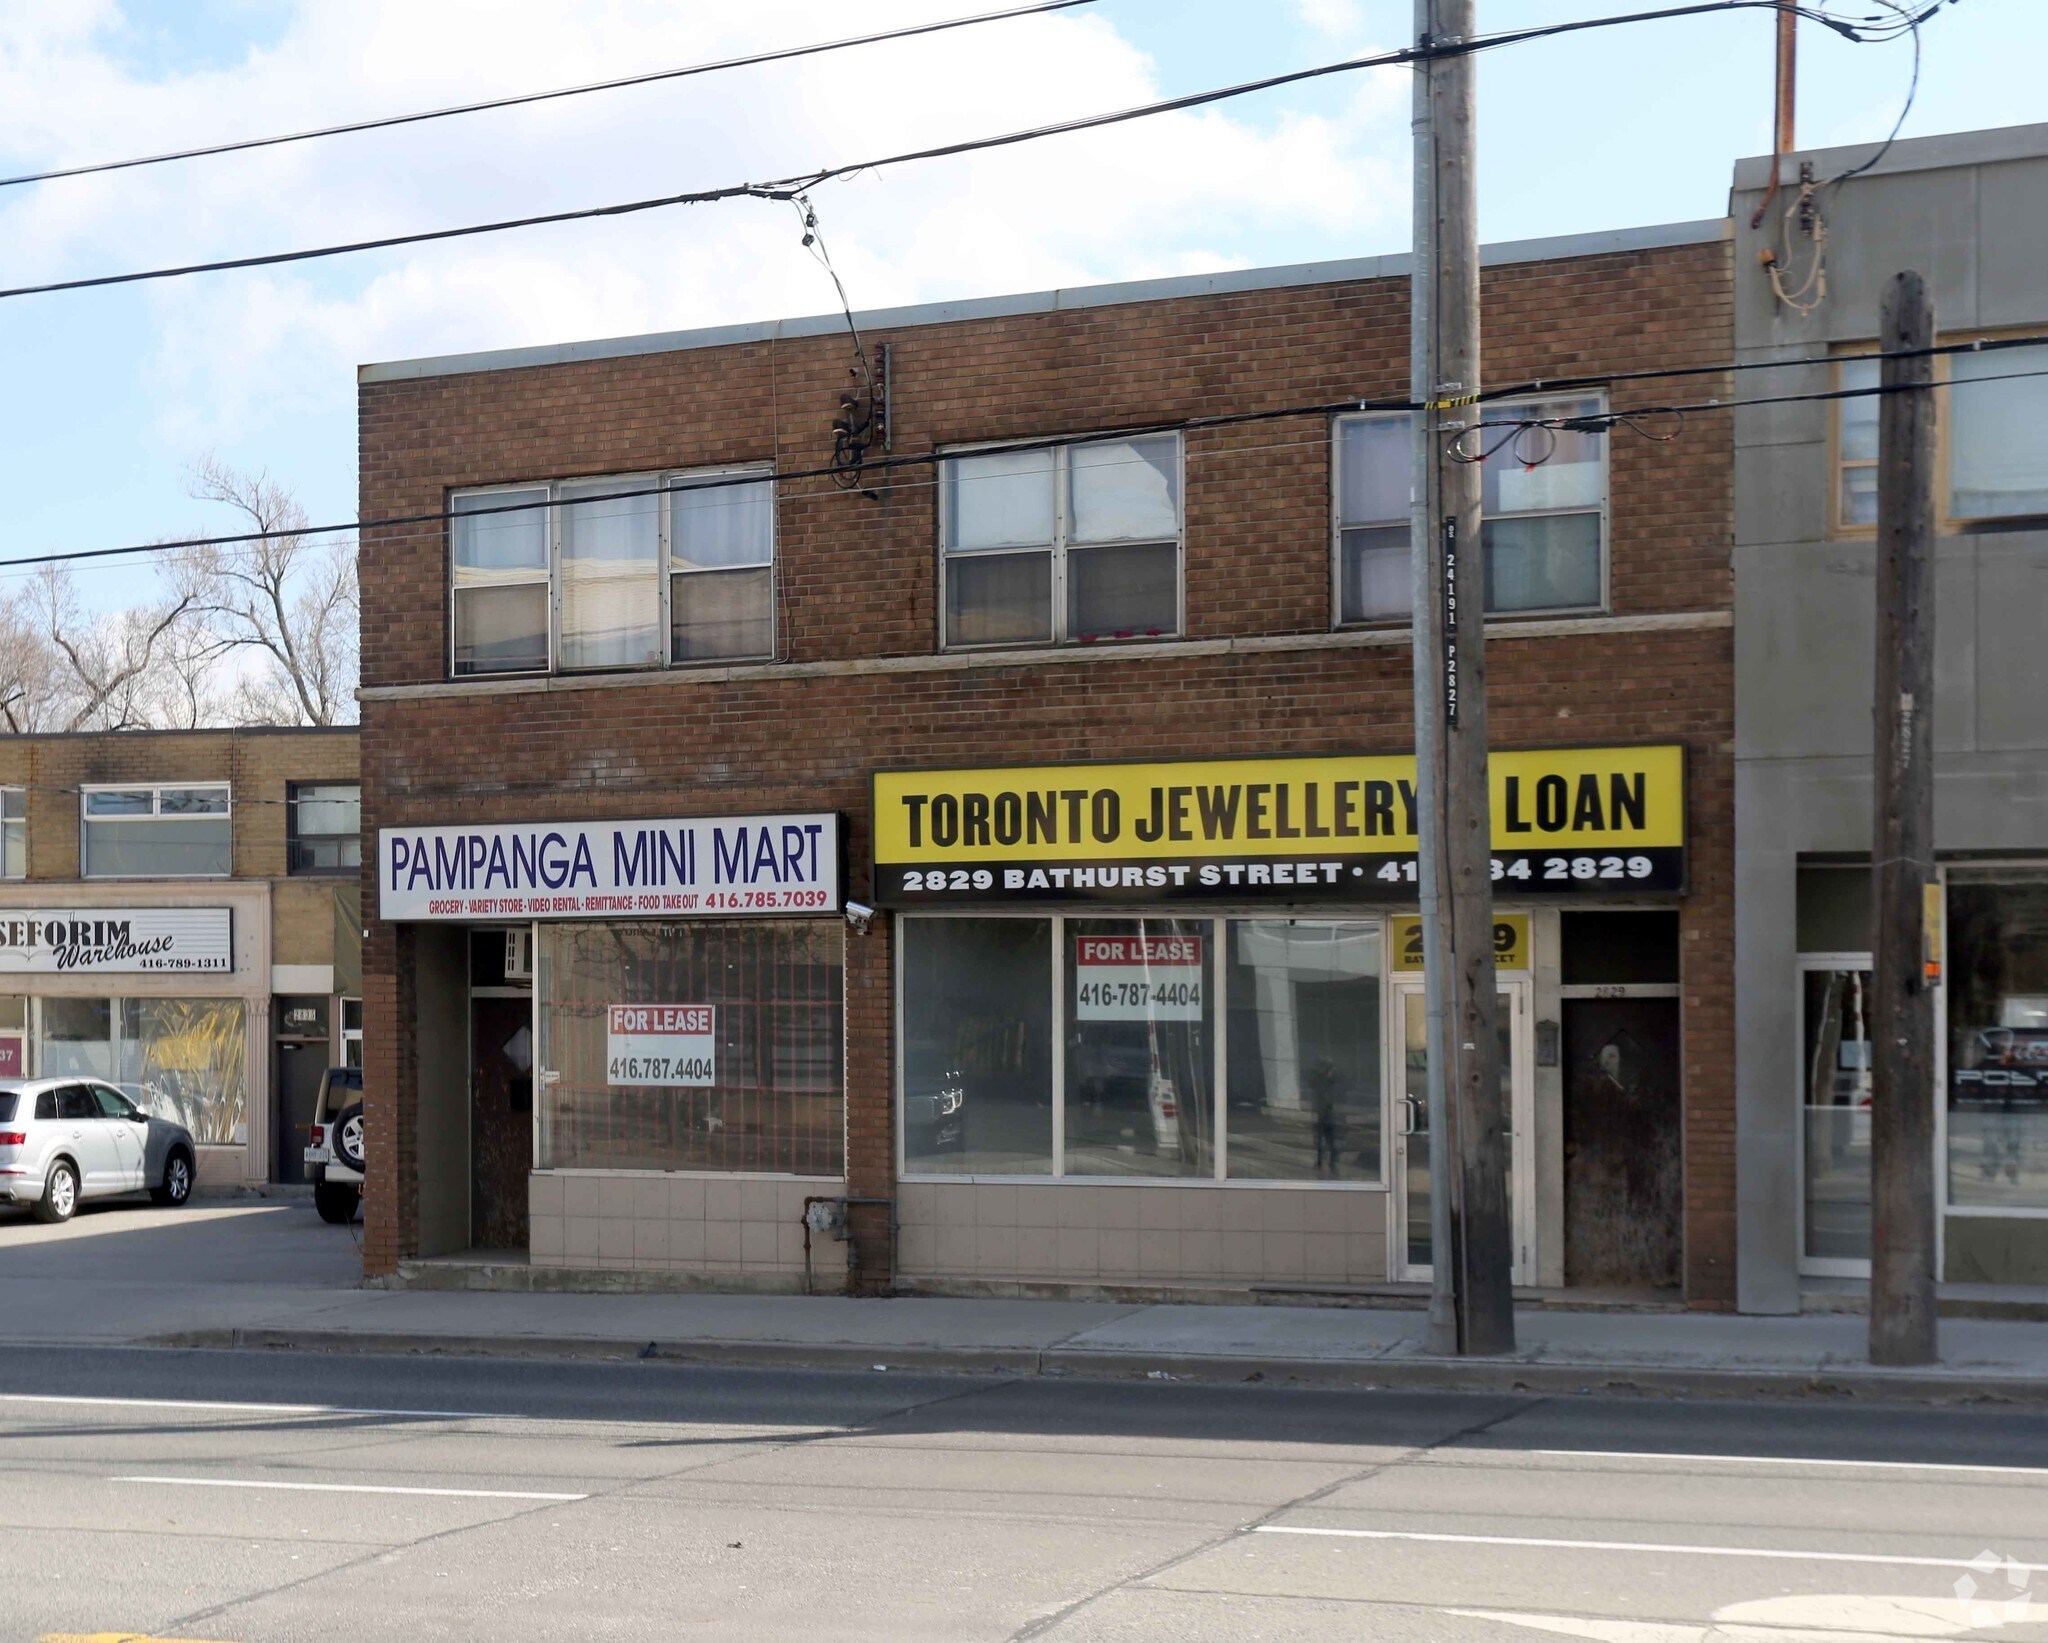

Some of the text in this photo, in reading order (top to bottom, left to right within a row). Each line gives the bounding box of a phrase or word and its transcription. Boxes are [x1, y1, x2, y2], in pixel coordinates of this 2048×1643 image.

[1446, 554, 1456, 625] 24191
[1448, 645, 1456, 716] P2827
[901, 772, 1646, 848] TORONTO JEWELLERY LOAN
[391, 824, 823, 892] PAMPANGA MINI MART
[902, 869, 994, 892] 2829
[1003, 865, 1190, 890] BATHURST
[1199, 863, 1343, 887] STREET
[1543, 855, 1653, 880] 2829
[429, 890, 827, 914] GROCERY VARIETY STORE VIDEO RENTAL REMITTANCE FOOD TAKE OUT 416.785.7039
[52, 934, 174, 970] Warehouse
[139, 958, 228, 969] 416-789-1311
[1084, 942, 1195, 960] FOR LEASE
[1079, 983, 1200, 1006] 416-787-4404
[613, 1010, 709, 1031] FOR LEASE
[609, 1057, 713, 1080] 416.787.4404
